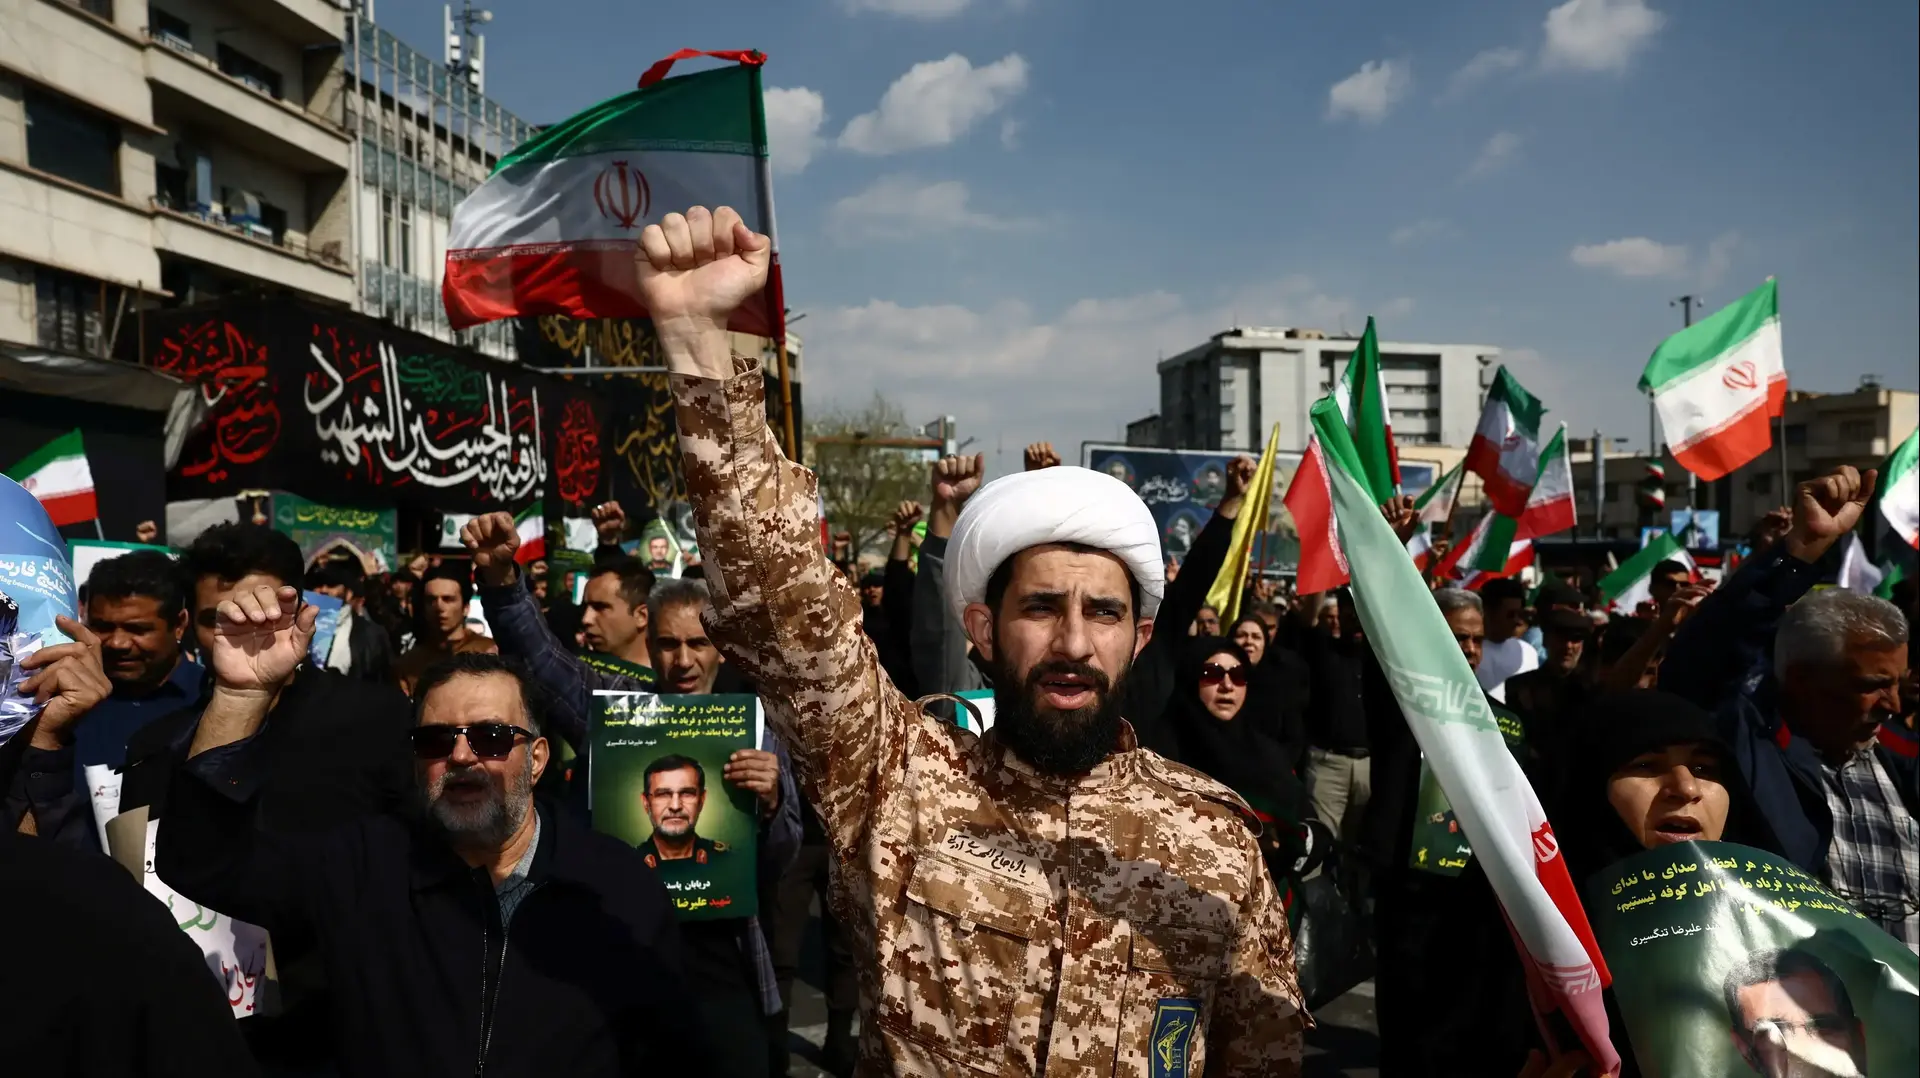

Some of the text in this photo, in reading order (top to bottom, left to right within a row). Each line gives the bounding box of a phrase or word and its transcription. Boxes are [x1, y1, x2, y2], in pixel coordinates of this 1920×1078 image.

[705, 704, 725, 714] میدان
[1661, 862, 1697, 880] صدای
[1745, 860, 1757, 872] هر
[1642, 870, 1655, 881] ما
[1739, 877, 1753, 889] ما
[664, 879, 711, 891] دریابان پاسد
[1611, 873, 1638, 895] ندای
[1660, 882, 1687, 900] کوفه
[1694, 880, 1716, 897] اهل
[1755, 877, 1783, 892] فریاد
[676, 896, 707, 911] علیرضا
[708, 895, 732, 908] شهید
[1769, 896, 1802, 913] خواه
[1630, 927, 1669, 947] تنگسیری
[1671, 922, 1702, 937] علیرضا
